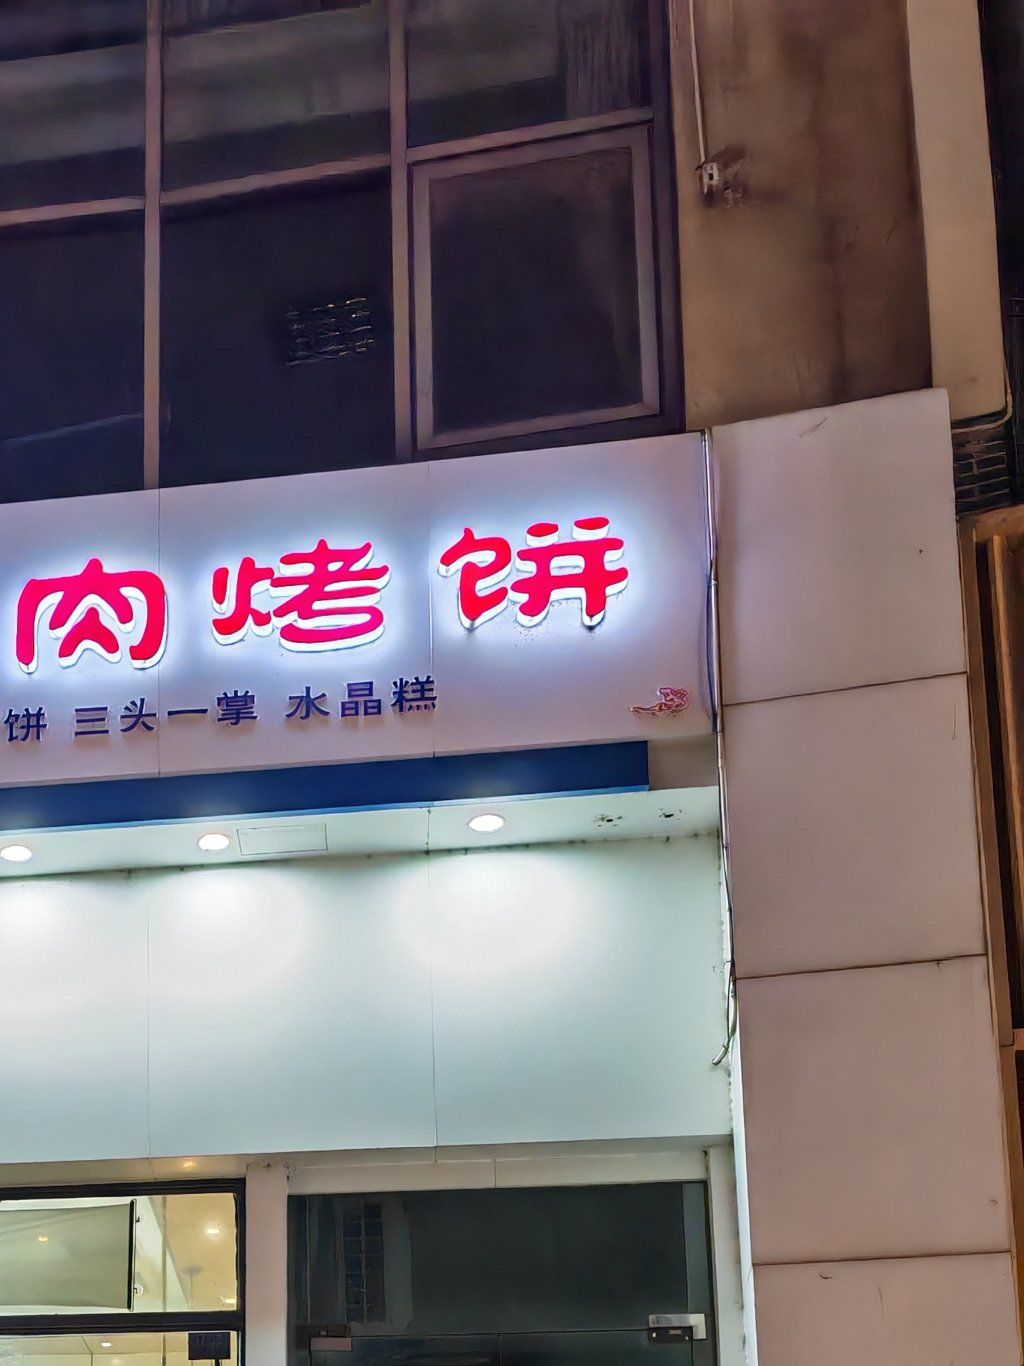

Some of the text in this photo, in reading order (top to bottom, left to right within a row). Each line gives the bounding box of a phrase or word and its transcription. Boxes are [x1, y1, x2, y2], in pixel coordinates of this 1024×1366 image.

[73, 688, 259, 738] 三头一掌
[284, 675, 438, 721] 水晶糕
